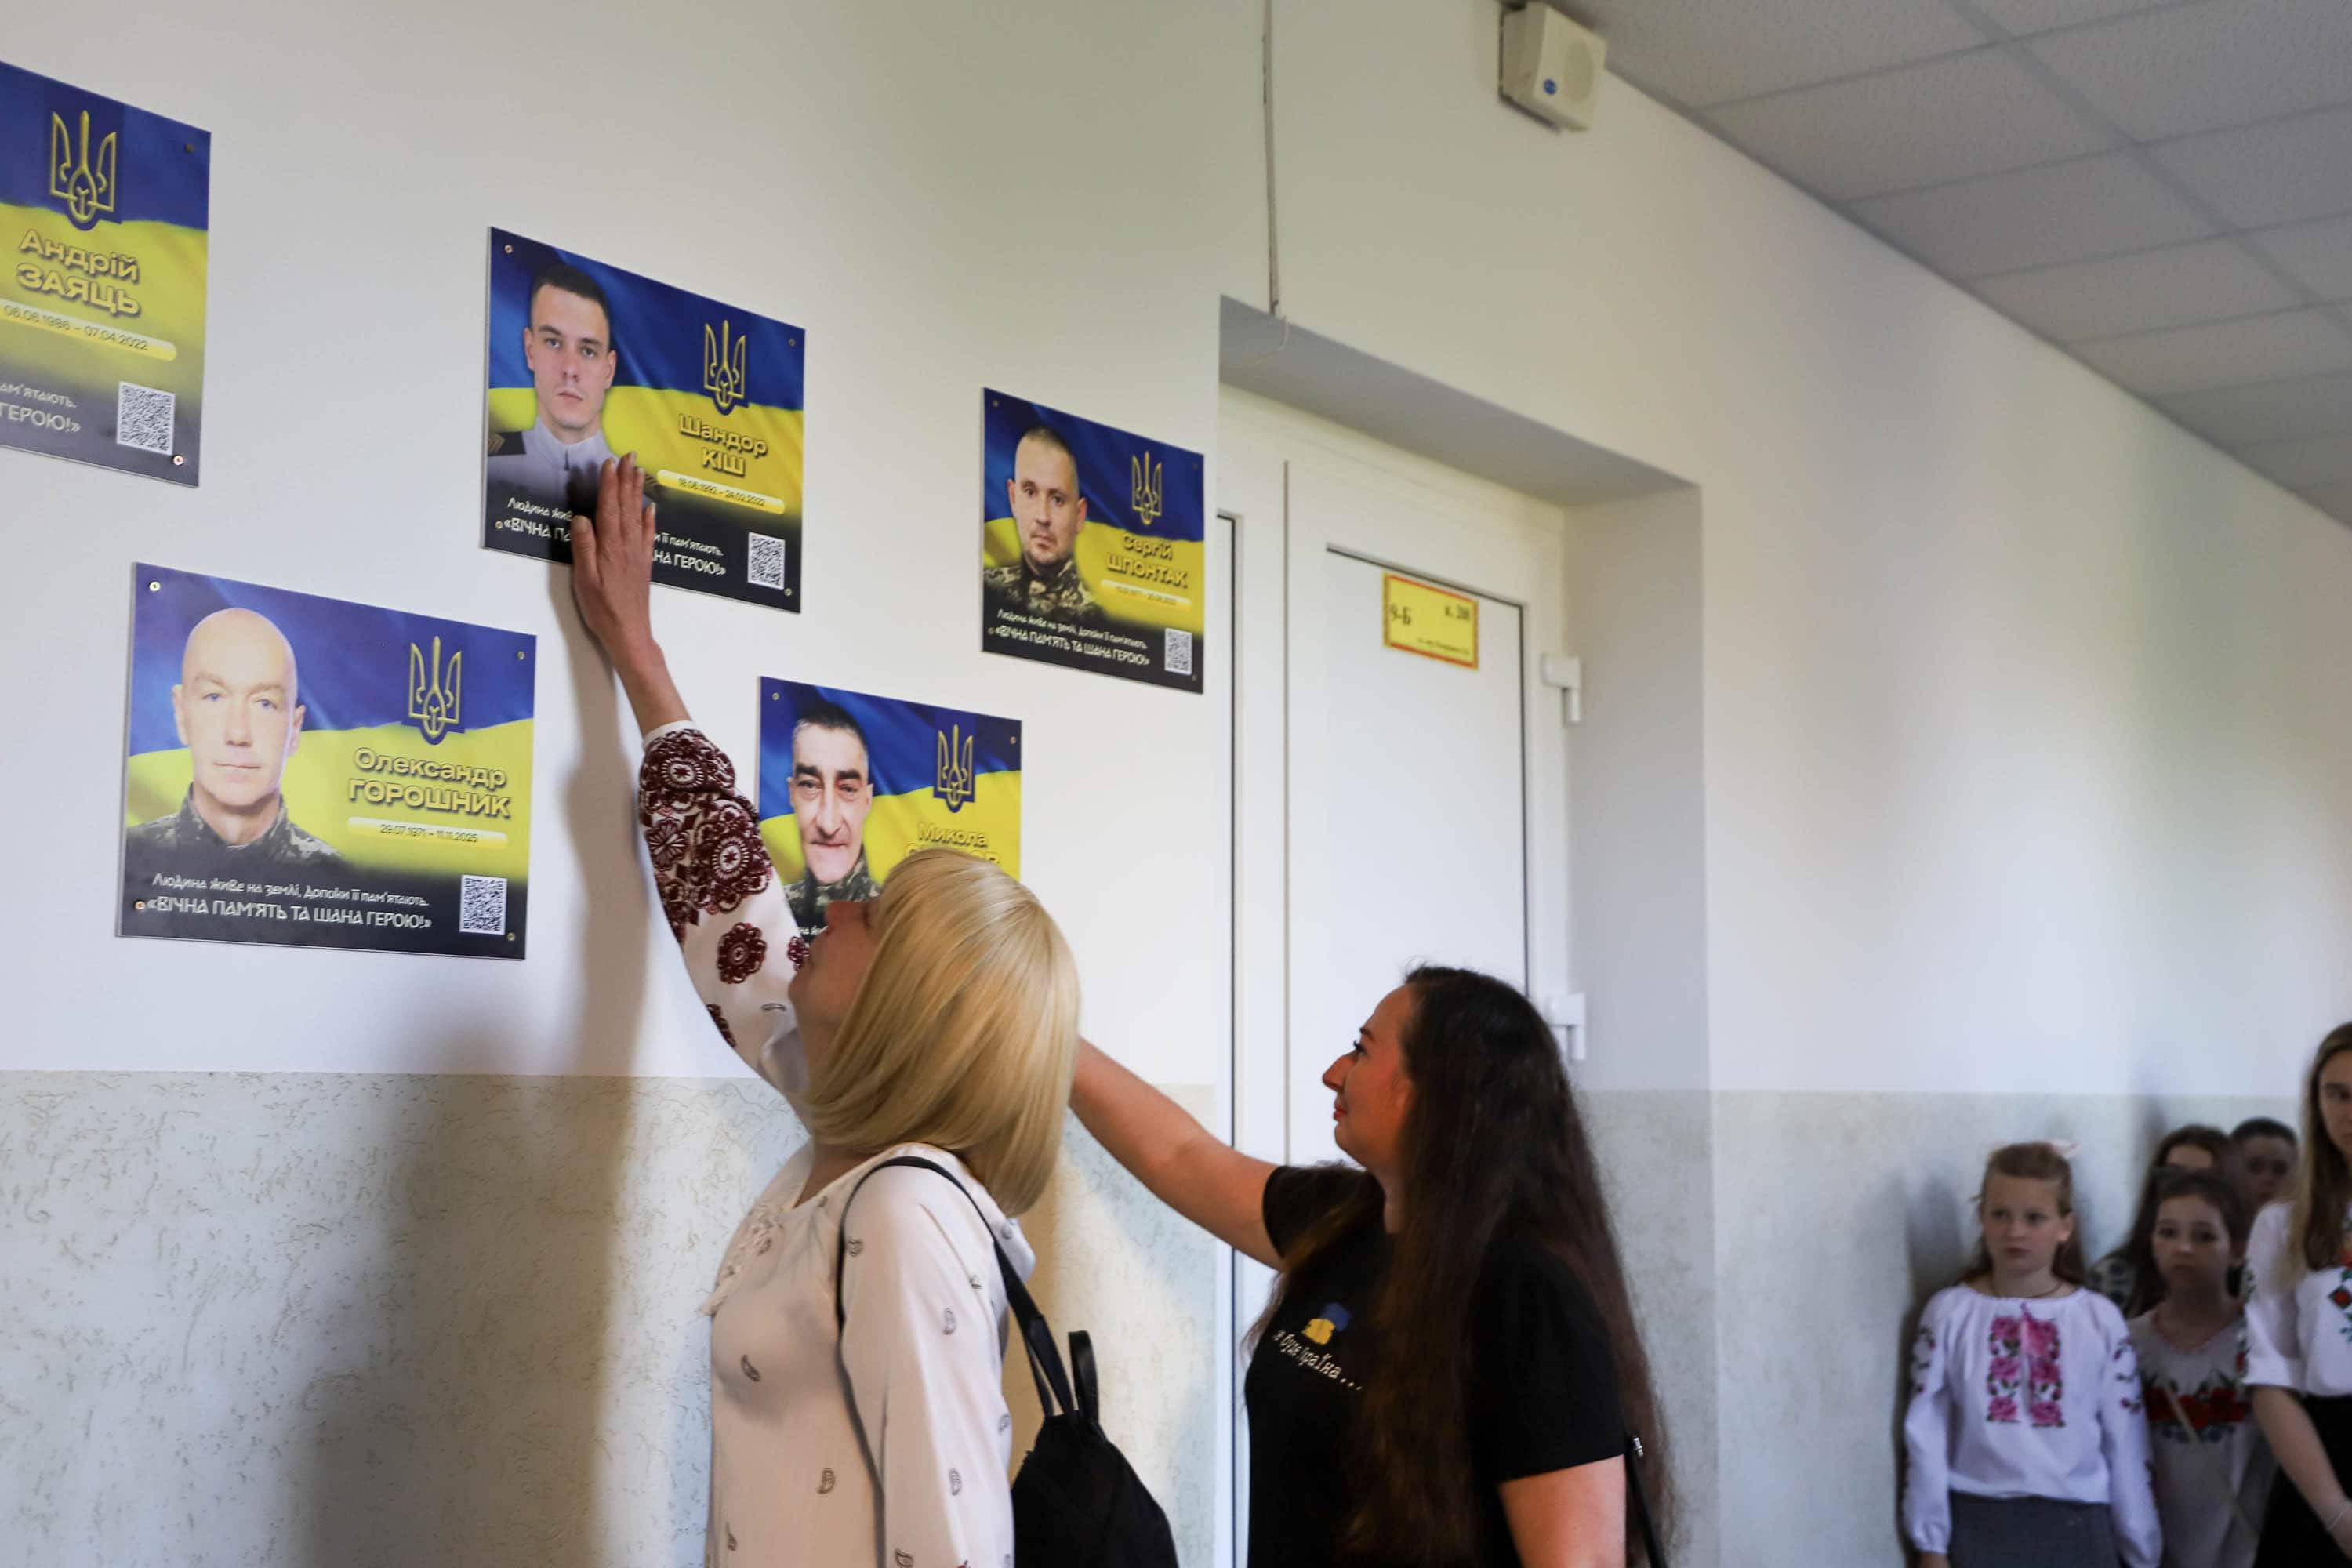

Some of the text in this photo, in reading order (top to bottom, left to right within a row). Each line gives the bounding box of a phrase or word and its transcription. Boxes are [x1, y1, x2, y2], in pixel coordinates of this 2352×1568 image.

[19, 228, 140, 284] Андрій
[16, 262, 142, 318] ЗАЯЦЬ
[0, 382, 77, 408] ам'ятають.
[678, 413, 768, 459] Шандор
[702, 447, 746, 478] КІШ
[507, 496, 573, 521] Людина жив
[503, 517, 552, 539] «ВІЧНА
[1122, 533, 1173, 561] Сергій
[1105, 552, 1189, 589] ШПОНТАК
[1071, 639, 1083, 653] ТА
[1083, 642, 1112, 659] ШАНА
[354, 746, 508, 792] Олександр
[347, 778, 514, 819] ГОРОШНИК
[917, 821, 989, 848] Микола
[152, 873, 208, 890] Людина
[209, 877, 245, 892] живе
[246, 884, 263, 893] на
[303, 885, 350, 900] допоки
[147, 895, 209, 914] «ВІЧНА
[289, 906, 311, 922] ТА
[313, 906, 364, 925] ШАНА
[366, 911, 433, 929] ГЕРОЮ!»
